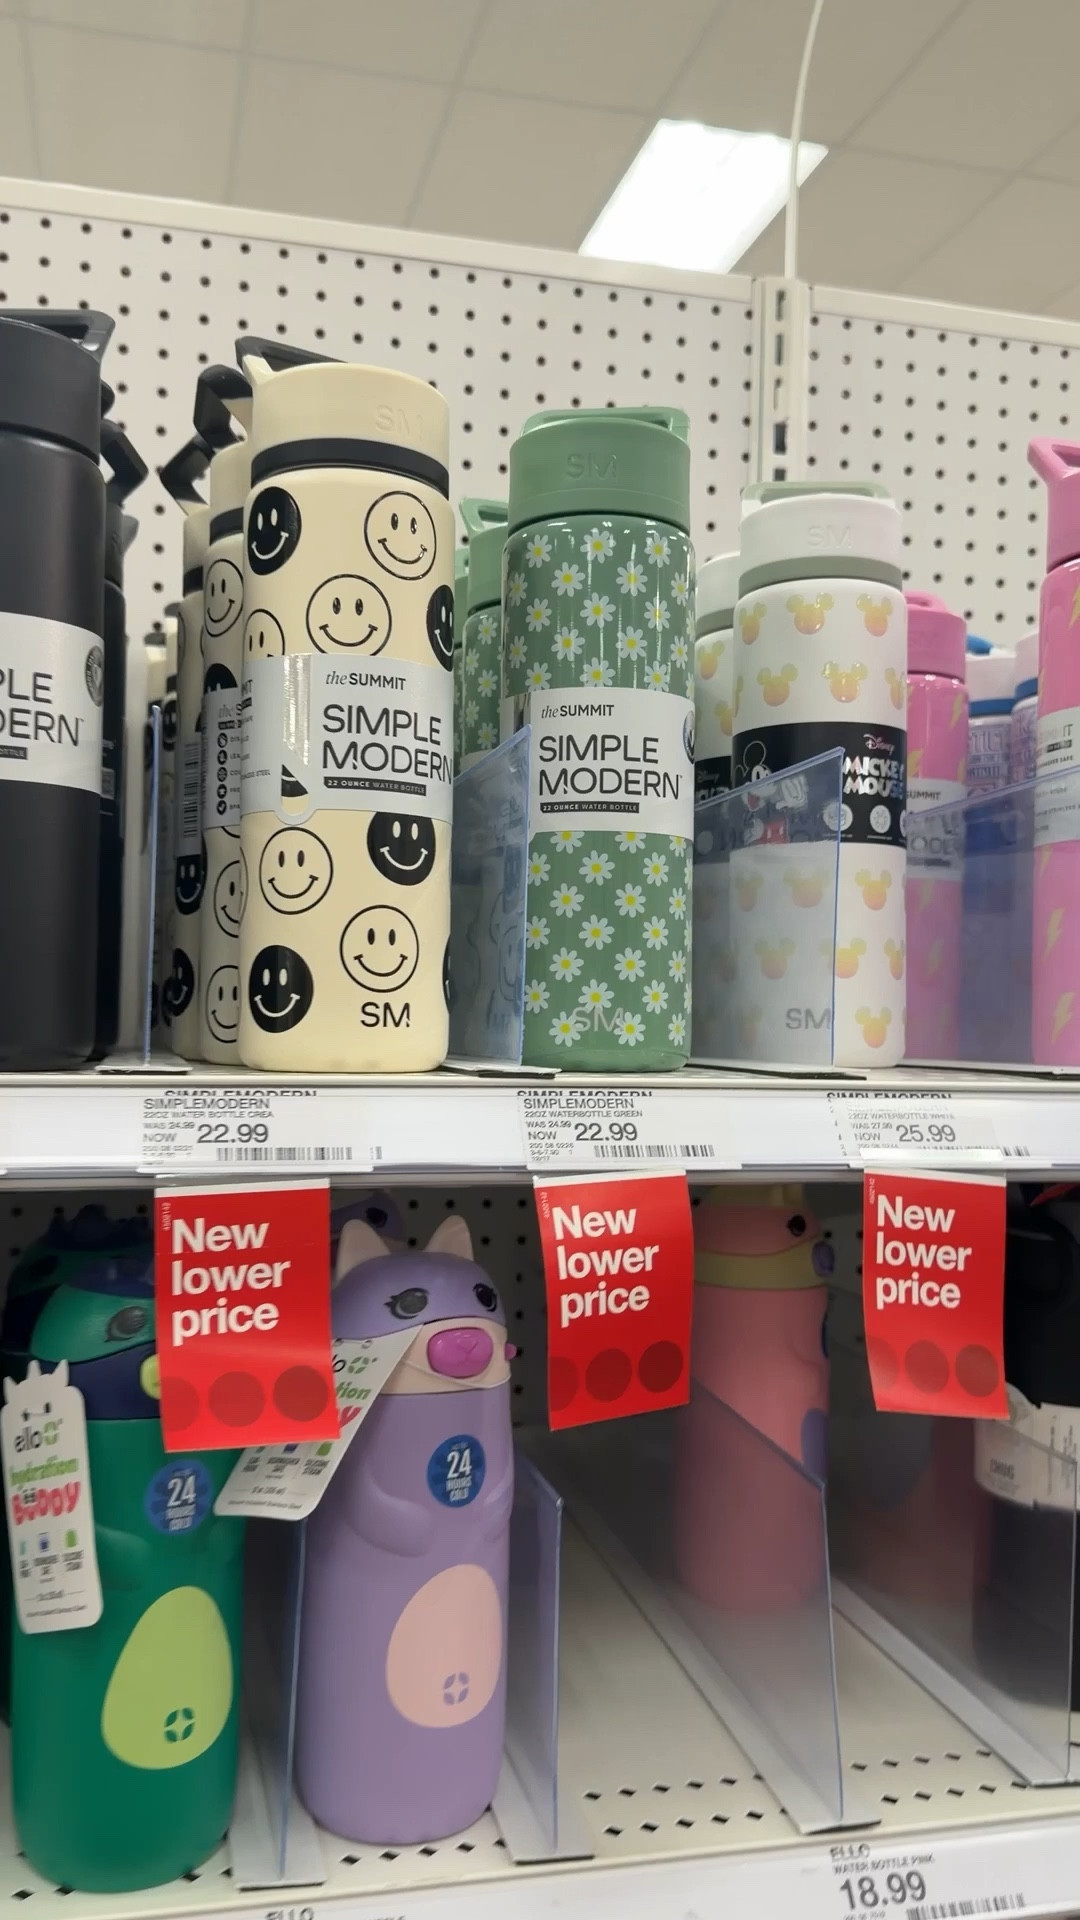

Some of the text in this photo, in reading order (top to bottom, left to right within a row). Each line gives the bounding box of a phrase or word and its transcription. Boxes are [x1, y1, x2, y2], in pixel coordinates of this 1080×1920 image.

[566, 453, 617, 480] SM
[0, 668, 52, 704] LE
[325, 671, 406, 690] the SUMMIT
[323, 703, 441, 746] SIMPLE
[541, 704, 614, 718] the SUMMIT
[539, 734, 659, 764] SIMPLE
[863, 734, 895, 756] Disney
[323, 740, 452, 785] MODERN
[327, 779, 426, 795] 22 OUNCE WATER BOTTLE
[539, 767, 680, 800] MODERN
[843, 776, 904, 800] MOUSE
[553, 803, 579, 811] OUNCE
[581, 803, 607, 811] WATER
[360, 1001, 410, 1028] SM
[571, 1007, 624, 1032] SM
[785, 1007, 834, 1030] SM
[143, 1098, 270, 1109] SIMPLEMODERN
[523, 1098, 634, 1109] SIMPLEMODERN
[142, 1123, 269, 1143] NOW 22.99
[525, 1121, 547, 1129] WAS
[528, 1122, 638, 1141] NOW 22.99
[854, 1124, 956, 1142] NOW 25.99
[551, 1204, 637, 1241] New
[877, 1194, 955, 1233] New
[172, 1217, 270, 1255] New
[556, 1244, 659, 1280] lower
[876, 1231, 972, 1272] lower
[172, 1260, 291, 1296] lower
[876, 1271, 961, 1310] price
[560, 1280, 650, 1328] price
[172, 1297, 280, 1347] price
[446, 1448, 472, 1479] 24
[167, 1475, 196, 1507] 24
[831, 1844, 870, 1862] ELLO
[841, 1871, 925, 1909] 18.99
